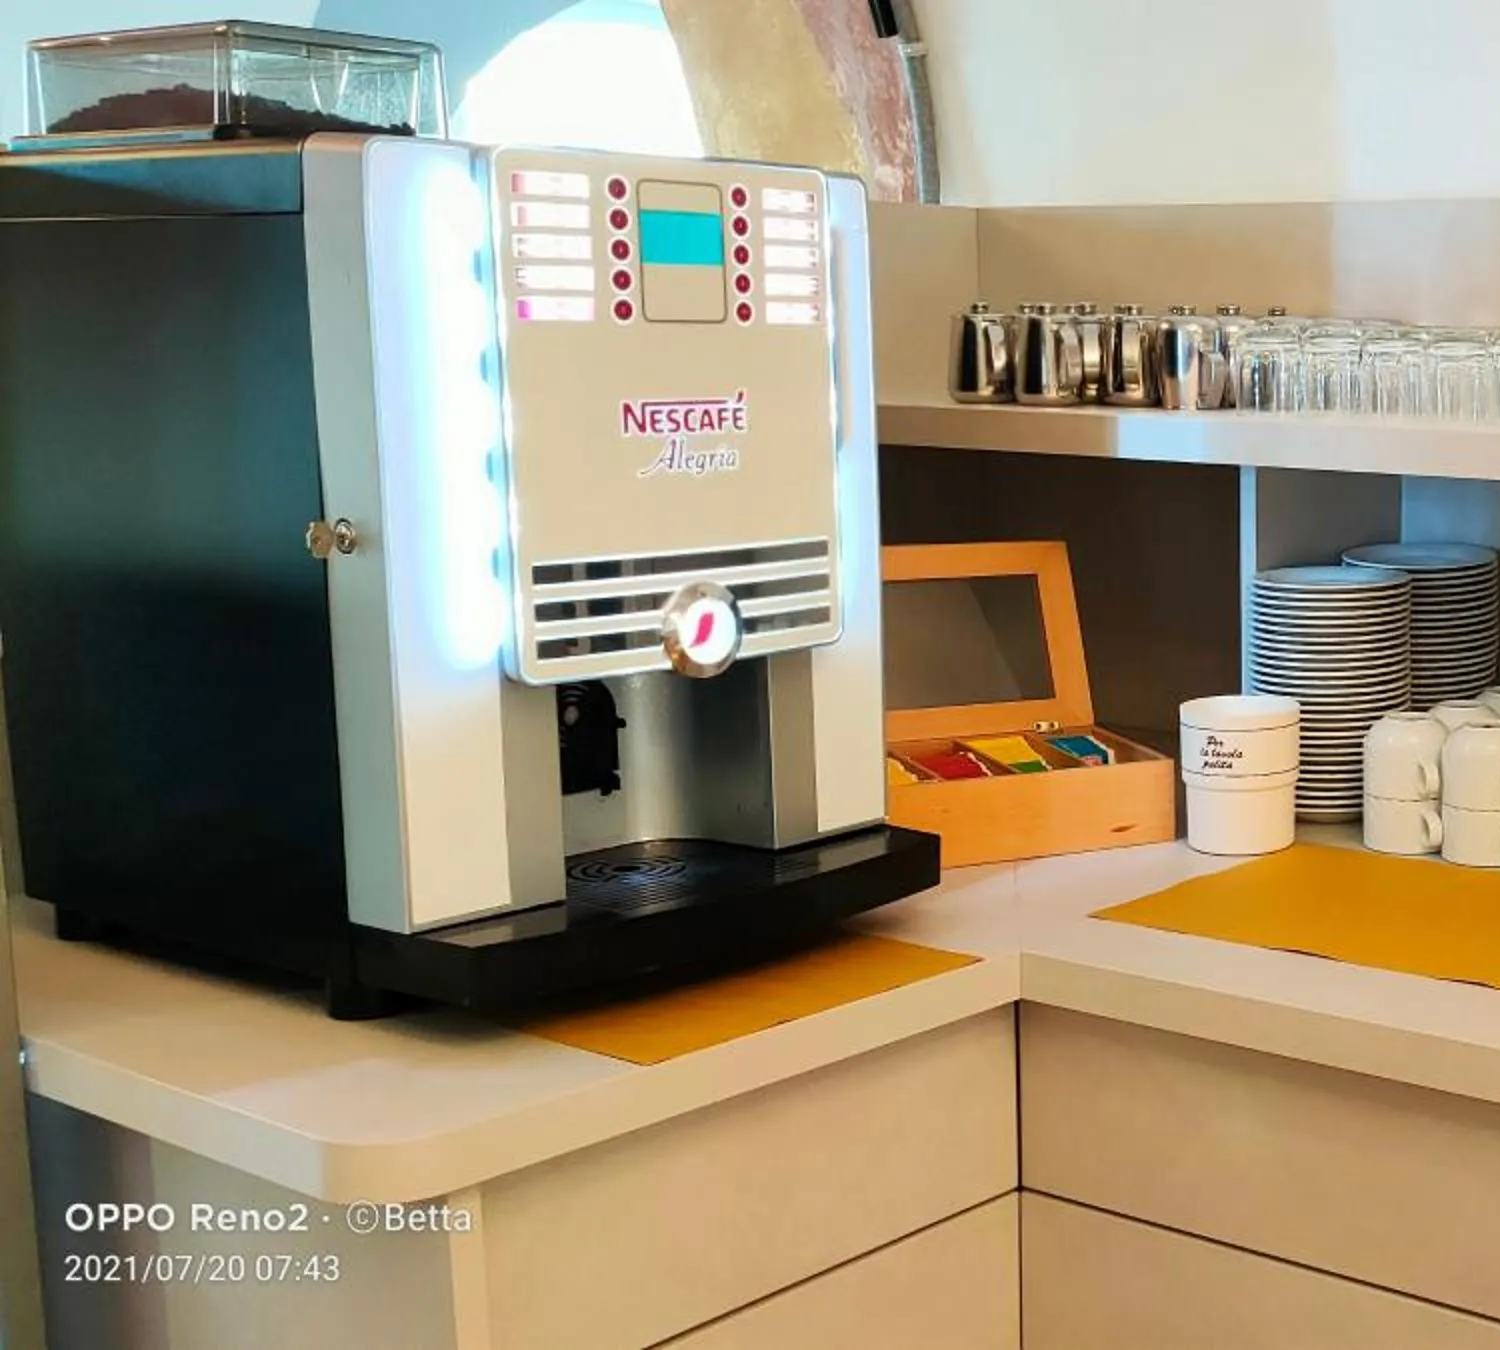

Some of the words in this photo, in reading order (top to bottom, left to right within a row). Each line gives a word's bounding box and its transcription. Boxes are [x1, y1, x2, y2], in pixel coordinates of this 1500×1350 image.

[622, 391, 746, 434] NESCAFÉ
[639, 437, 737, 476] Alegria
[1205, 735, 1224, 746] Per
